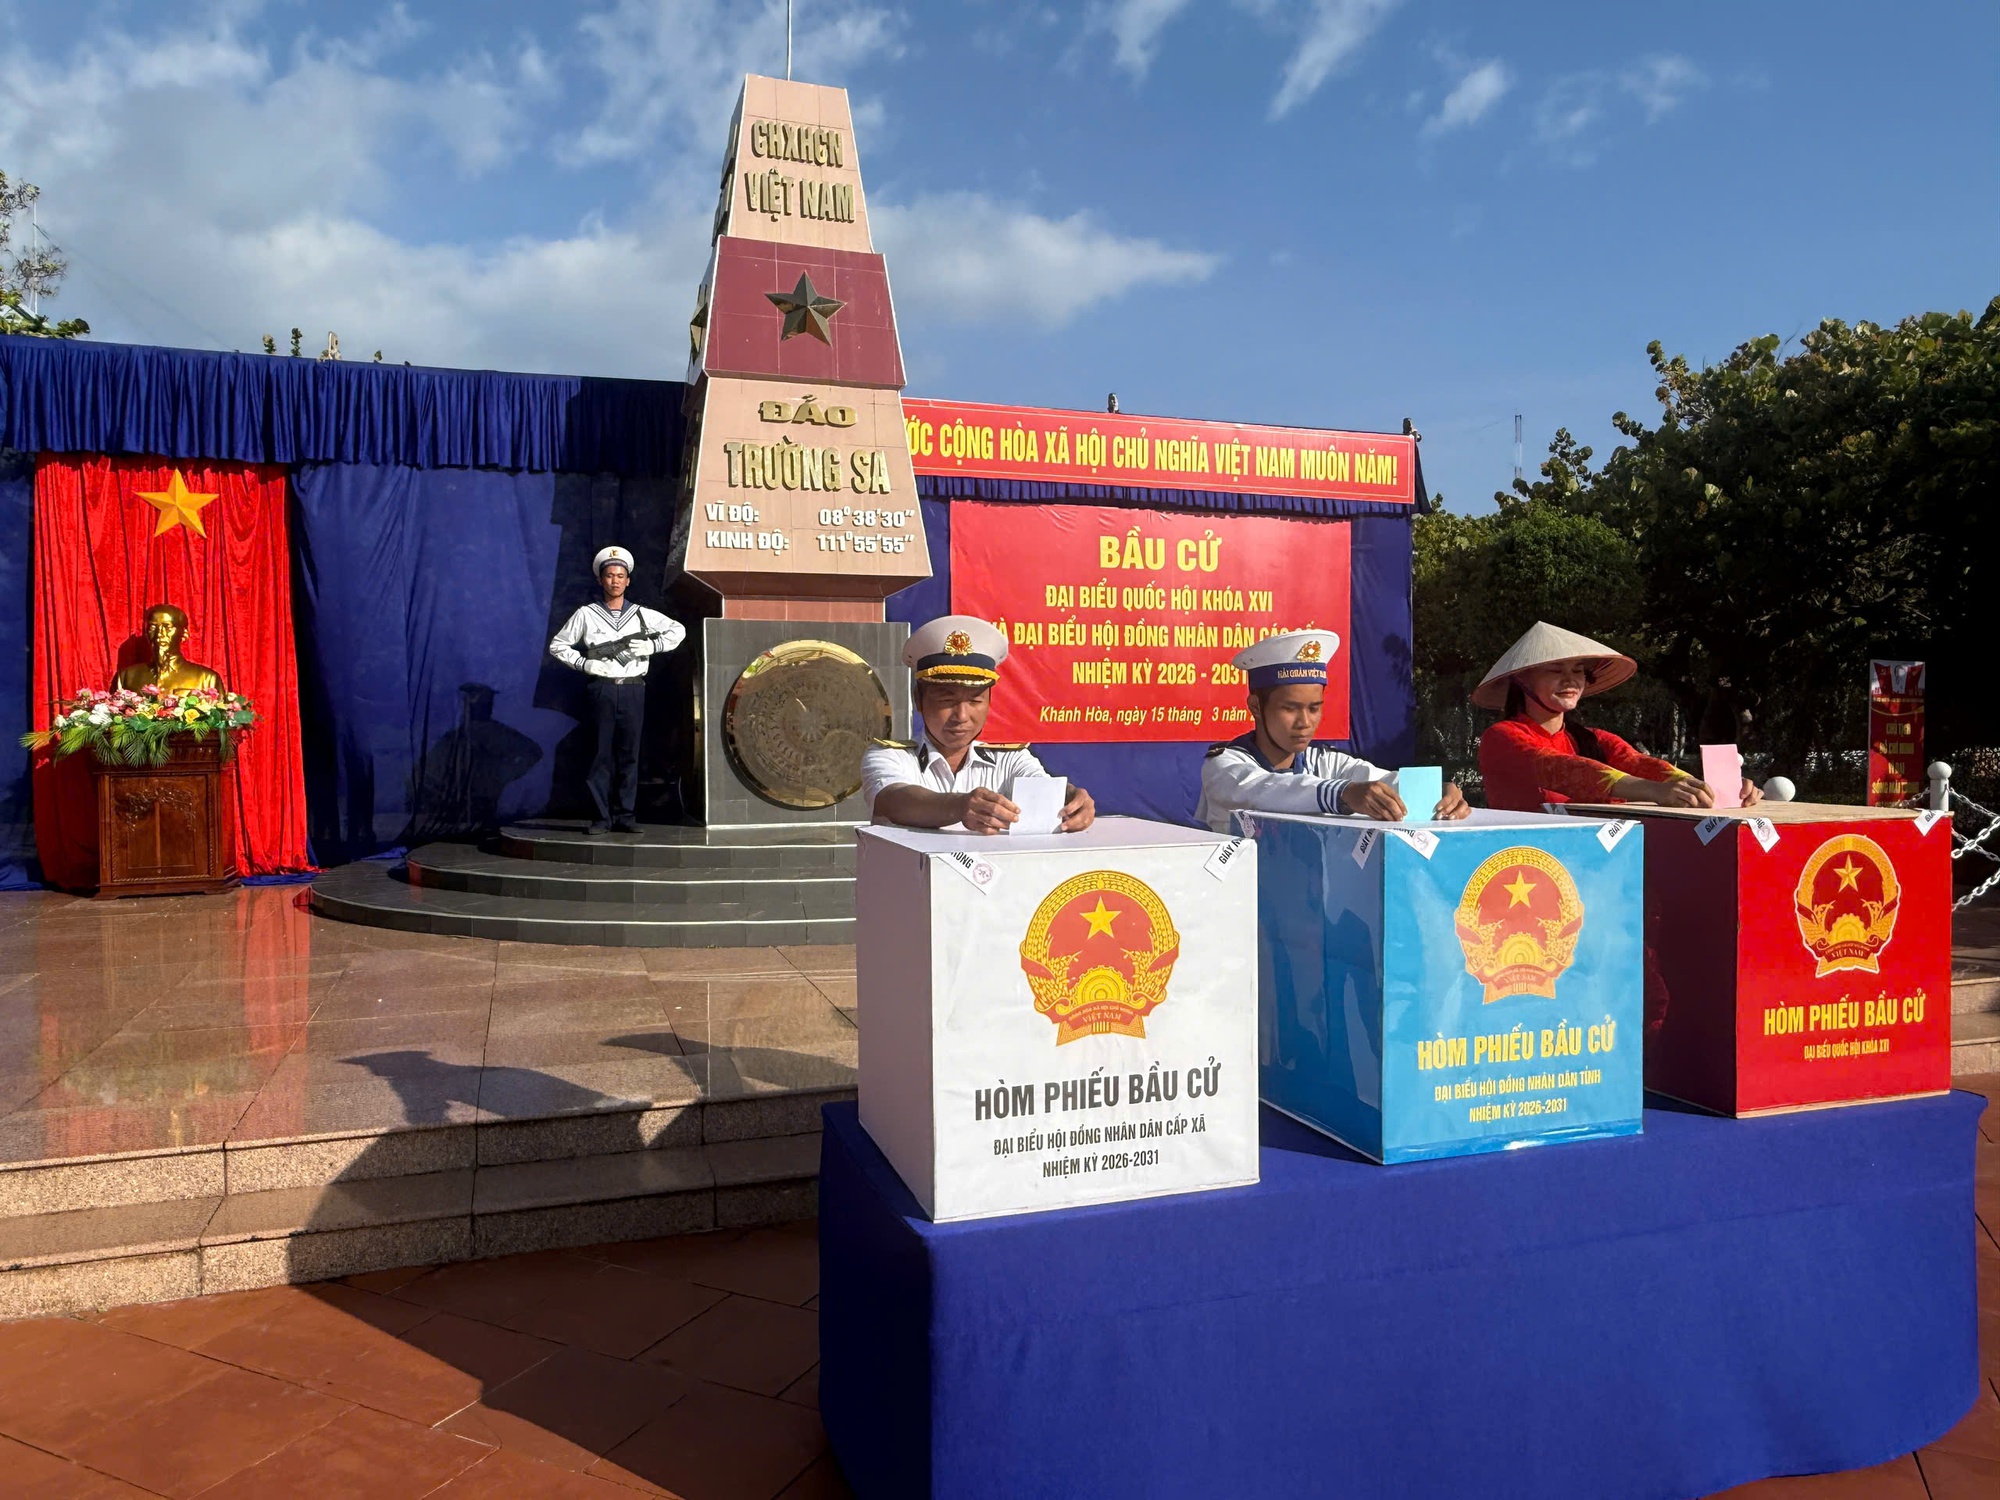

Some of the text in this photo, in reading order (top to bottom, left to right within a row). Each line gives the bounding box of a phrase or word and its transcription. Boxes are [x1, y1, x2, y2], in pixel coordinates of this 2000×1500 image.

[744, 166, 794, 222] VIỆT
[800, 177, 856, 224] NAM
[758, 394, 858, 428] ĐẢO
[724, 435, 891, 494] TRƯỜNG SA
[940, 418, 993, 466] CỘNG
[1000, 420, 1039, 463] HÒA
[1044, 425, 1071, 465] XÃ
[1076, 427, 1107, 474] HỘI
[1112, 427, 1149, 470] CHỦ
[1155, 435, 1209, 474] NGHĨA
[1214, 437, 1250, 482] VIỆT
[1256, 446, 1295, 479] NAM
[1300, 444, 1350, 483] MUÔN
[1354, 447, 1398, 486] NĂM!
[705, 500, 724, 522] VĨ
[728, 502, 760, 526] ĐỘ:
[706, 531, 752, 550] KINH
[757, 529, 790, 556] ĐỘ:
[1099, 526, 1223, 572] BẦU CỬ
[1045, 578, 1273, 616] ĐẠI BIỂU QUỐC HỘI KHÓA XVI
[1014, 622, 1043, 650] ĐẠI
[1048, 615, 1086, 647] BIỂU
[1091, 621, 1119, 651] HỘI
[1124, 617, 1168, 647] ĐỒNG
[1174, 621, 1218, 648] NHÂN
[1222, 622, 1255, 648] DÂN
[1072, 657, 1127, 688] NHIỆM
[1131, 658, 1152, 684] KỲ
[1157, 663, 1196, 685] 2026
[1039, 706, 1081, 723] Khánh
[1085, 706, 1113, 724] Hòa,
[1116, 708, 1148, 727] ngày
[1151, 707, 1164, 722] 15
[1168, 707, 1202, 727] tháng
[1211, 706, 1220, 722] 3
[1222, 706, 1248, 722] năm
[1764, 987, 1927, 1036] HÒM PHIẾU BẦU CỬ
[1417, 1014, 1617, 1070] HÒM PHIẾU BẦU CỬ
[975, 1056, 1222, 1121] HÒM PHIẾU BẦU CỬ
[1434, 1086, 1452, 1104] ĐẠI
[1479, 1077, 1496, 1098] HỘI
[1527, 1071, 1555, 1091] NHÂN
[1557, 1069, 1578, 1087] DÂN
[1469, 1097, 1567, 1124] NHIỆM KỲ 2026-2031
[993, 1137, 1014, 1159] ĐẠI
[1017, 1128, 1043, 1154] BIỂU
[1046, 1128, 1067, 1153] HỘI
[1104, 1120, 1136, 1143] NHÂN
[1166, 1113, 1188, 1136] CẤP
[1191, 1113, 1206, 1133] XÃ
[1042, 1149, 1160, 1179] NHIỆM KỲ 2026-2031
